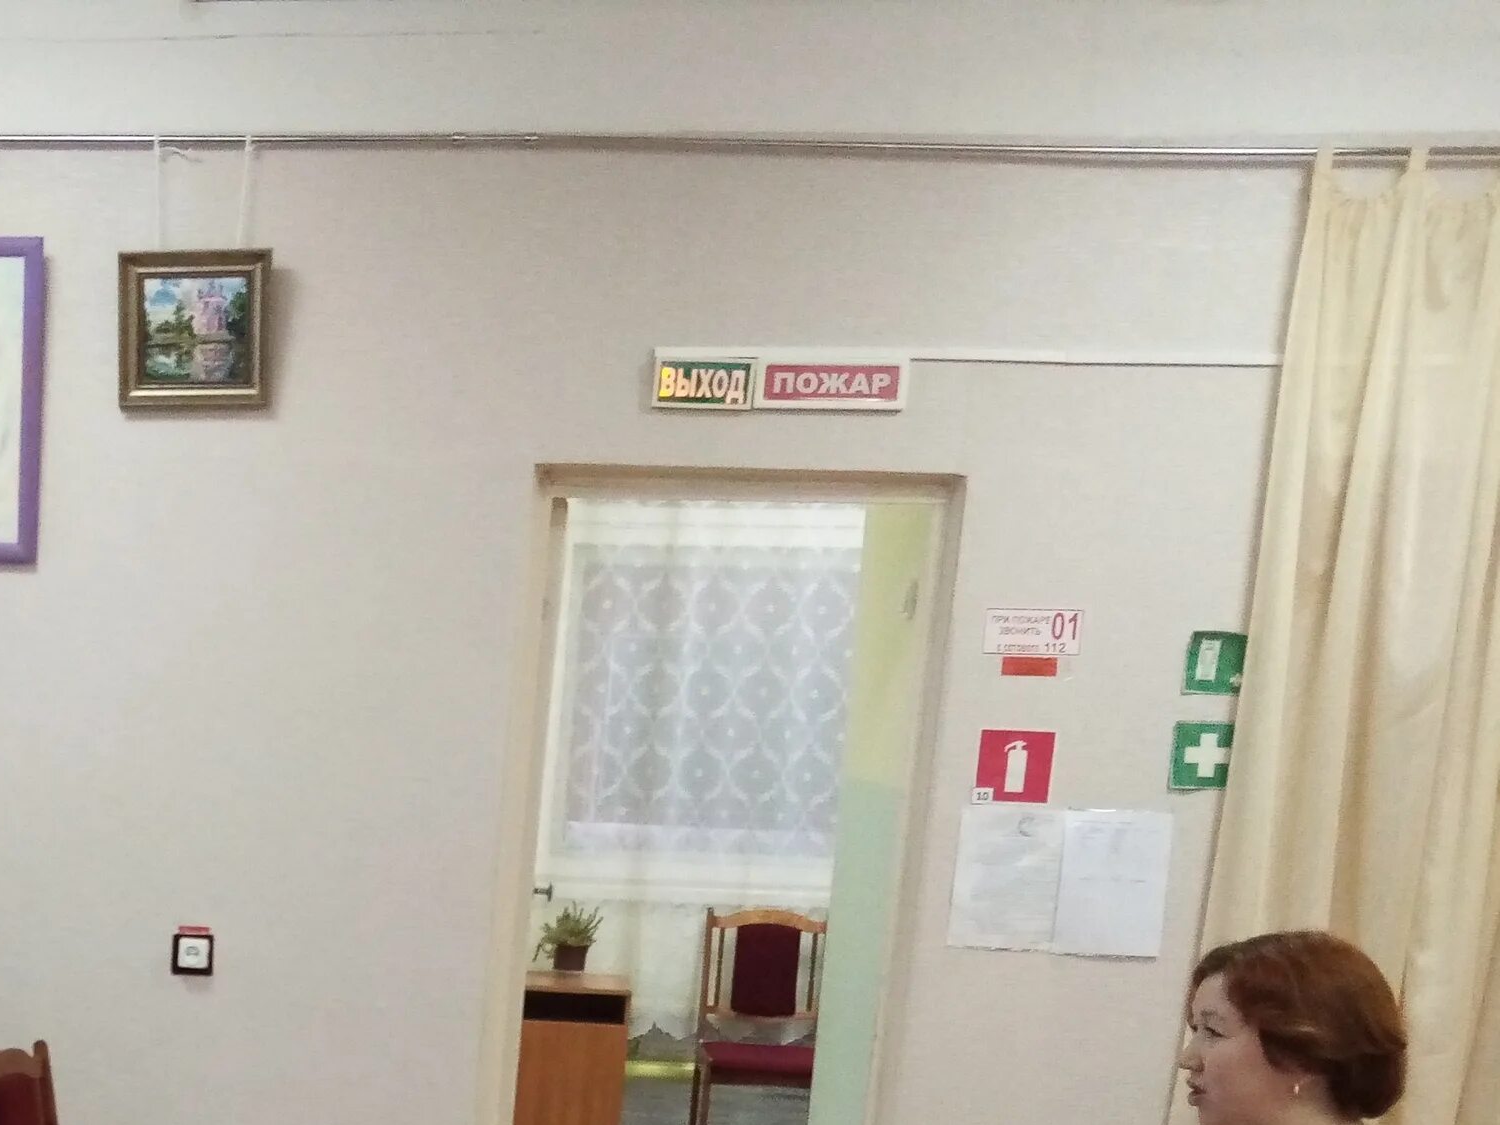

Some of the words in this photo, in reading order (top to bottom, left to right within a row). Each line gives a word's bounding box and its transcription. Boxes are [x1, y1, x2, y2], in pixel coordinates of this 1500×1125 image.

[658, 366, 747, 404] ВЫХОД
[772, 372, 892, 395] ПОЖАР
[1052, 612, 1079, 640] 01
[1044, 642, 1067, 653] 112
